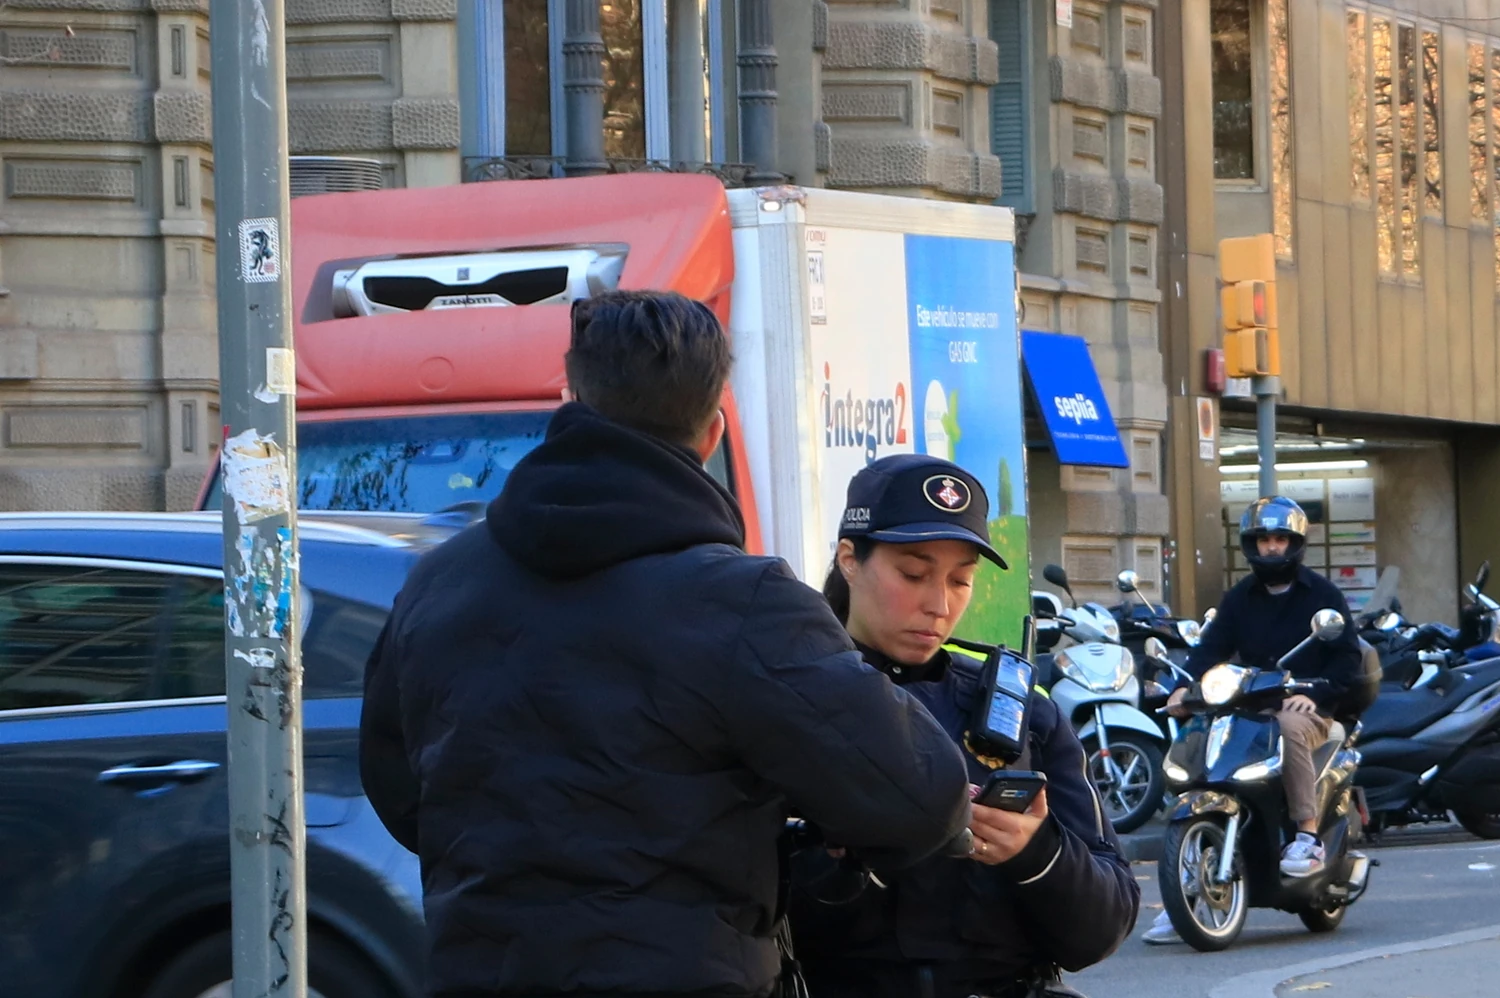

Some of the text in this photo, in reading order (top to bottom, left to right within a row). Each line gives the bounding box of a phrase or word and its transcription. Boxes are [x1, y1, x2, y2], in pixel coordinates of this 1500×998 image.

[441, 297, 492, 306] ZANOTTI
[916, 304, 931, 327] Este
[948, 341, 978, 363] GAS GNC
[820, 361, 907, 466] integra2
